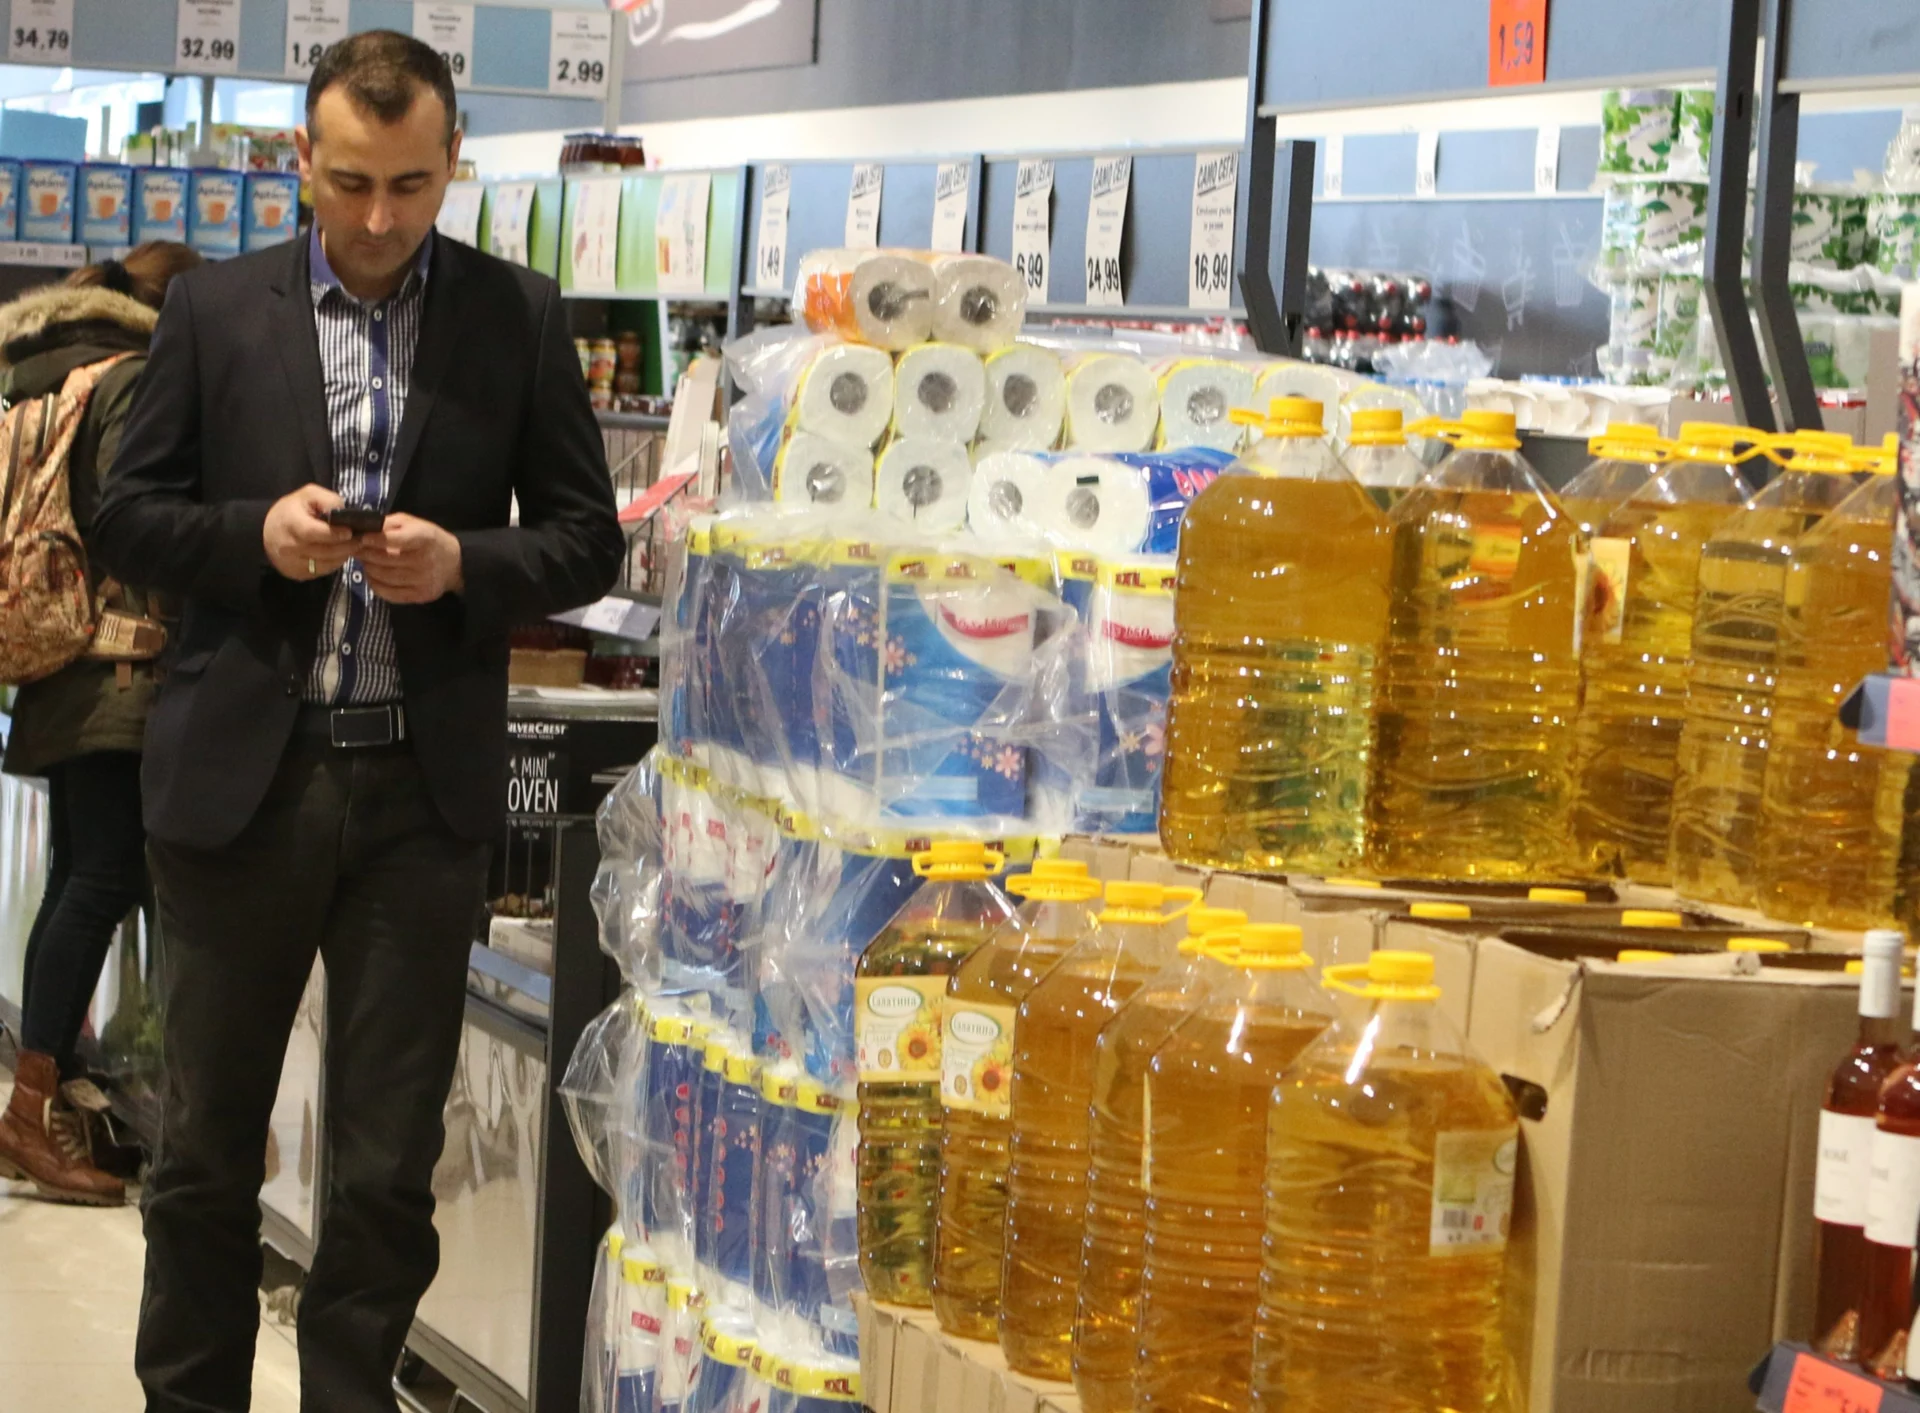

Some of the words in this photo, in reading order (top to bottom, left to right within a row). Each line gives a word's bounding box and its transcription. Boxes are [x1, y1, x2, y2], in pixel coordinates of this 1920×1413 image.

[14, 27, 69, 49] 34,79
[180, 37, 235, 61] 32,99
[1499, 21, 1533, 72] 1,59
[557, 58, 604, 83] 2,99
[761, 246, 780, 281] 1,49
[1088, 256, 1119, 294] 24,99
[1195, 253, 1228, 294] 16,99
[1115, 572, 1146, 588] XXL
[521, 756, 548, 778] MINI
[508, 778, 559, 813] OVEN
[824, 1376, 855, 1395] XXL
